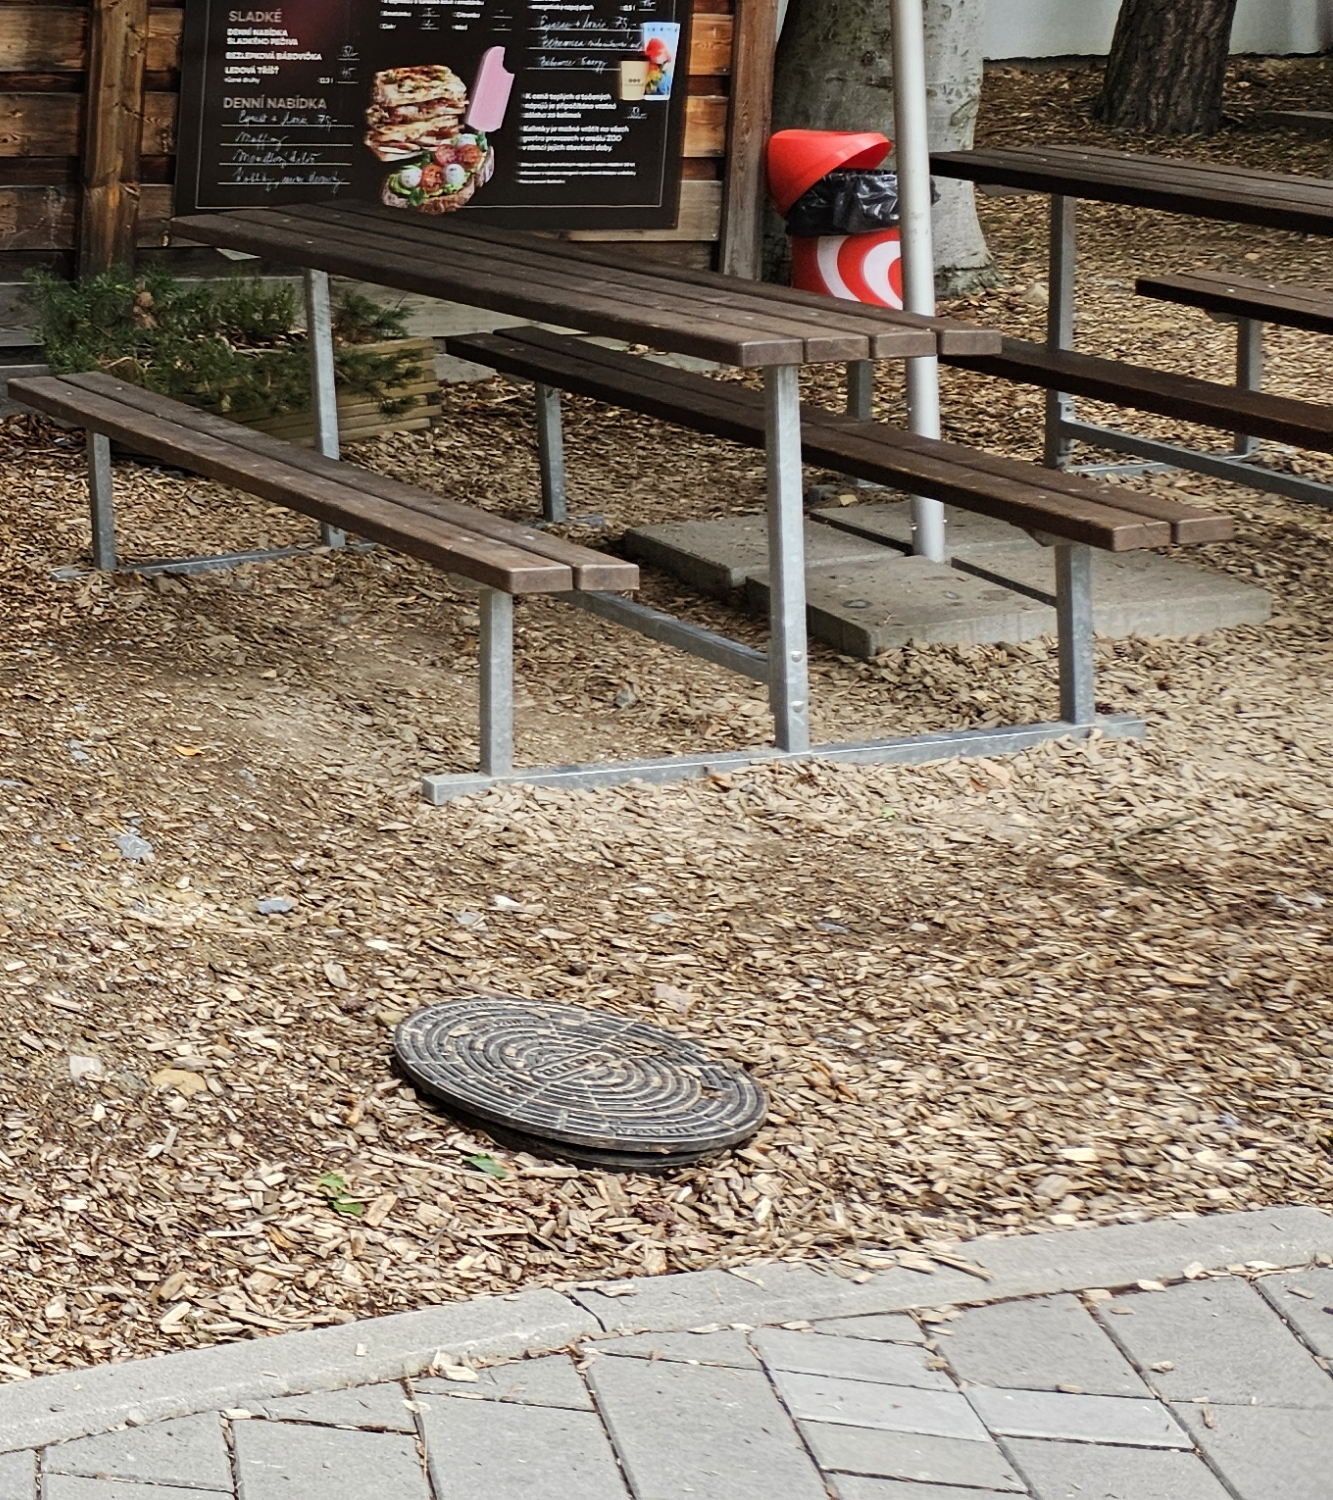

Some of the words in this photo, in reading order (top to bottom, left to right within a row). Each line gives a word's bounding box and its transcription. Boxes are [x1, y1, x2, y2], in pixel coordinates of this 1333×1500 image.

[229, 8, 282, 23] SLADKÉ
[223, 94, 265, 109] DENNÍ
[267, 95, 327, 109] NABÍDKA
